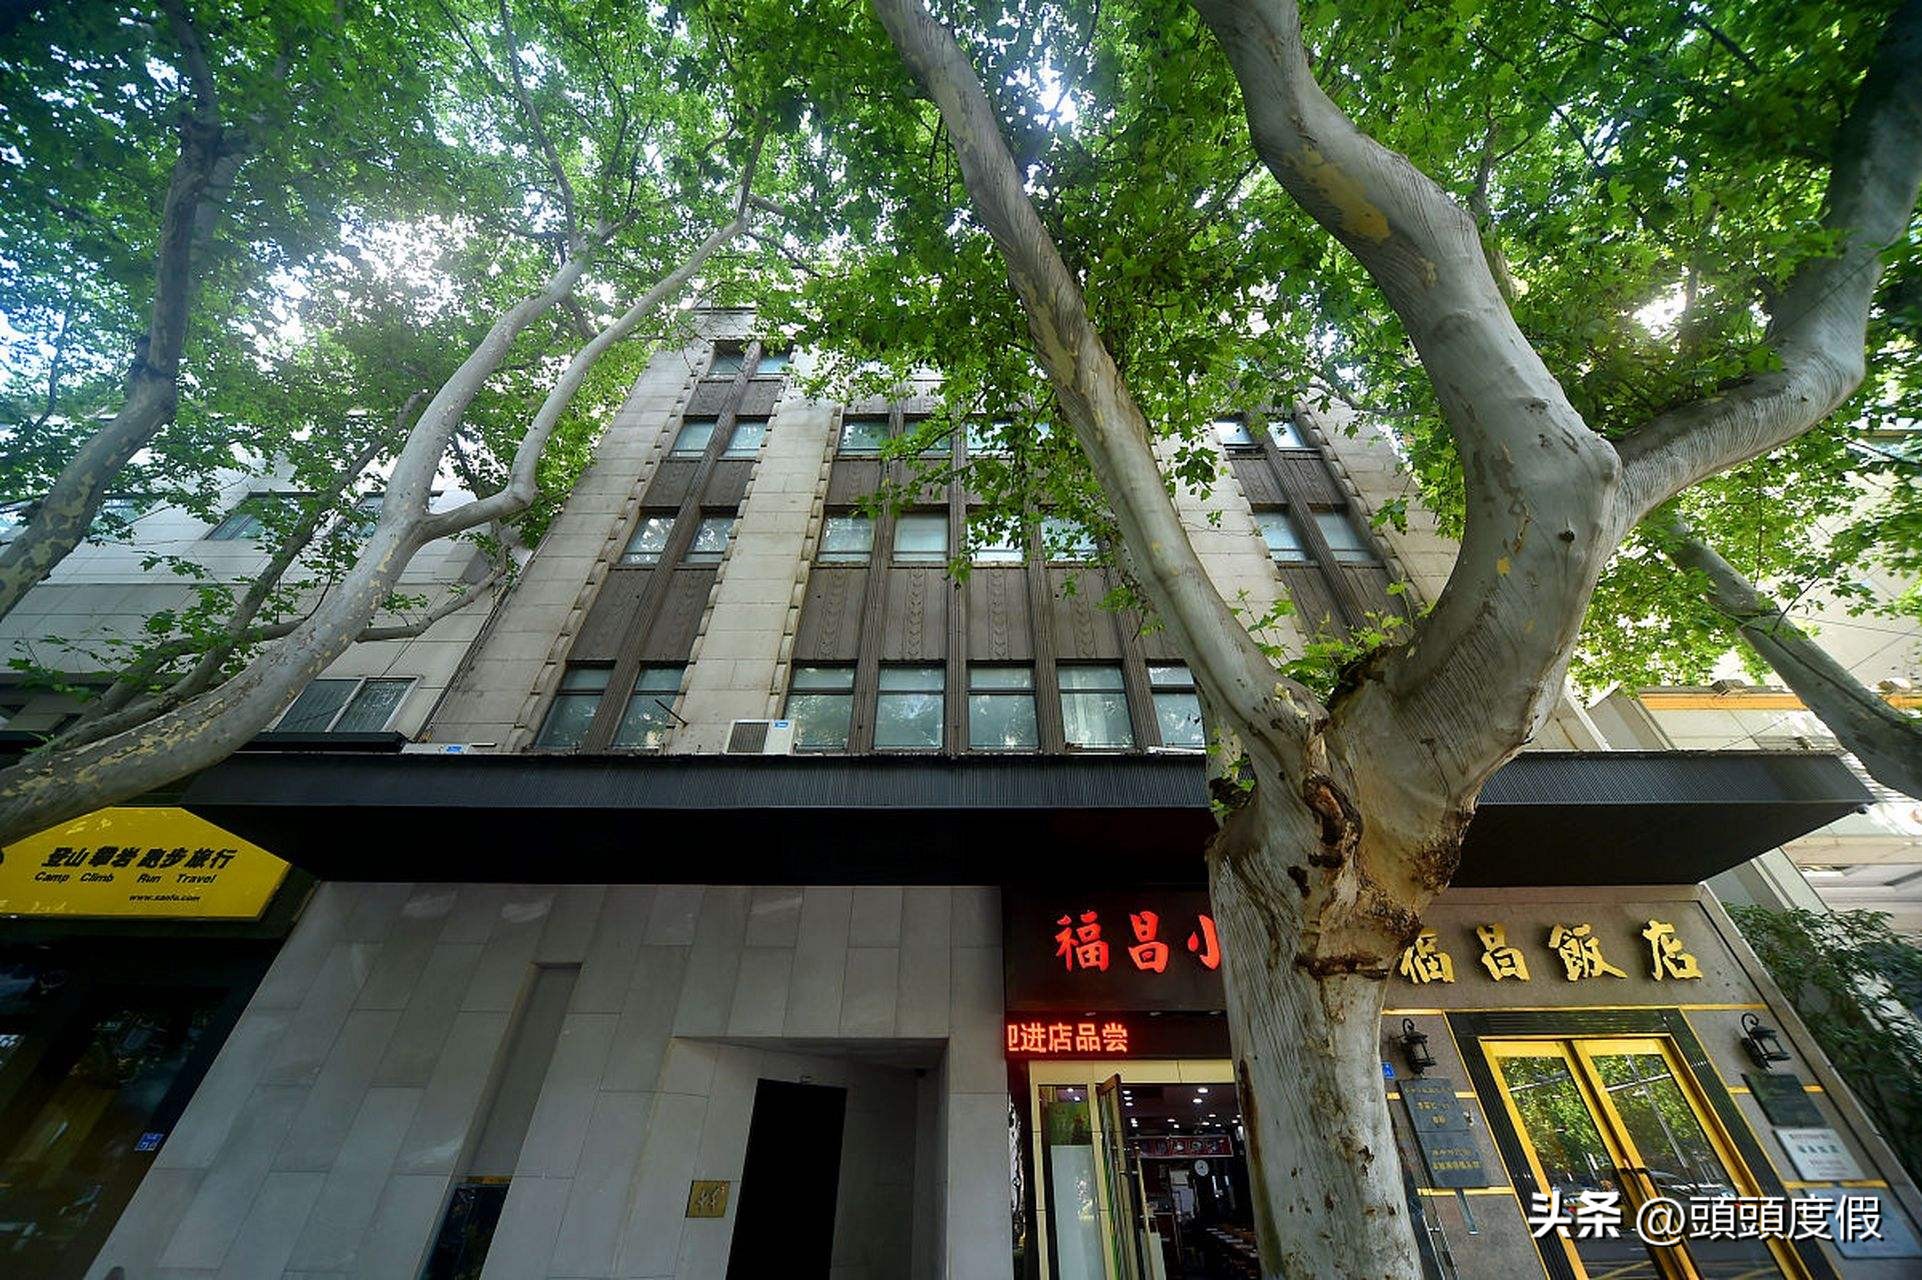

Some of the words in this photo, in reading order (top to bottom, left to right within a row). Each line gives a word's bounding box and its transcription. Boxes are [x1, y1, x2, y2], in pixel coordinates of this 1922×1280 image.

[184, 847, 238, 869] 旅行
[34, 871, 71, 883] Camp
[80, 872, 114, 882] Climb
[137, 873, 162, 883] Run
[176, 873, 217, 883] Travel
